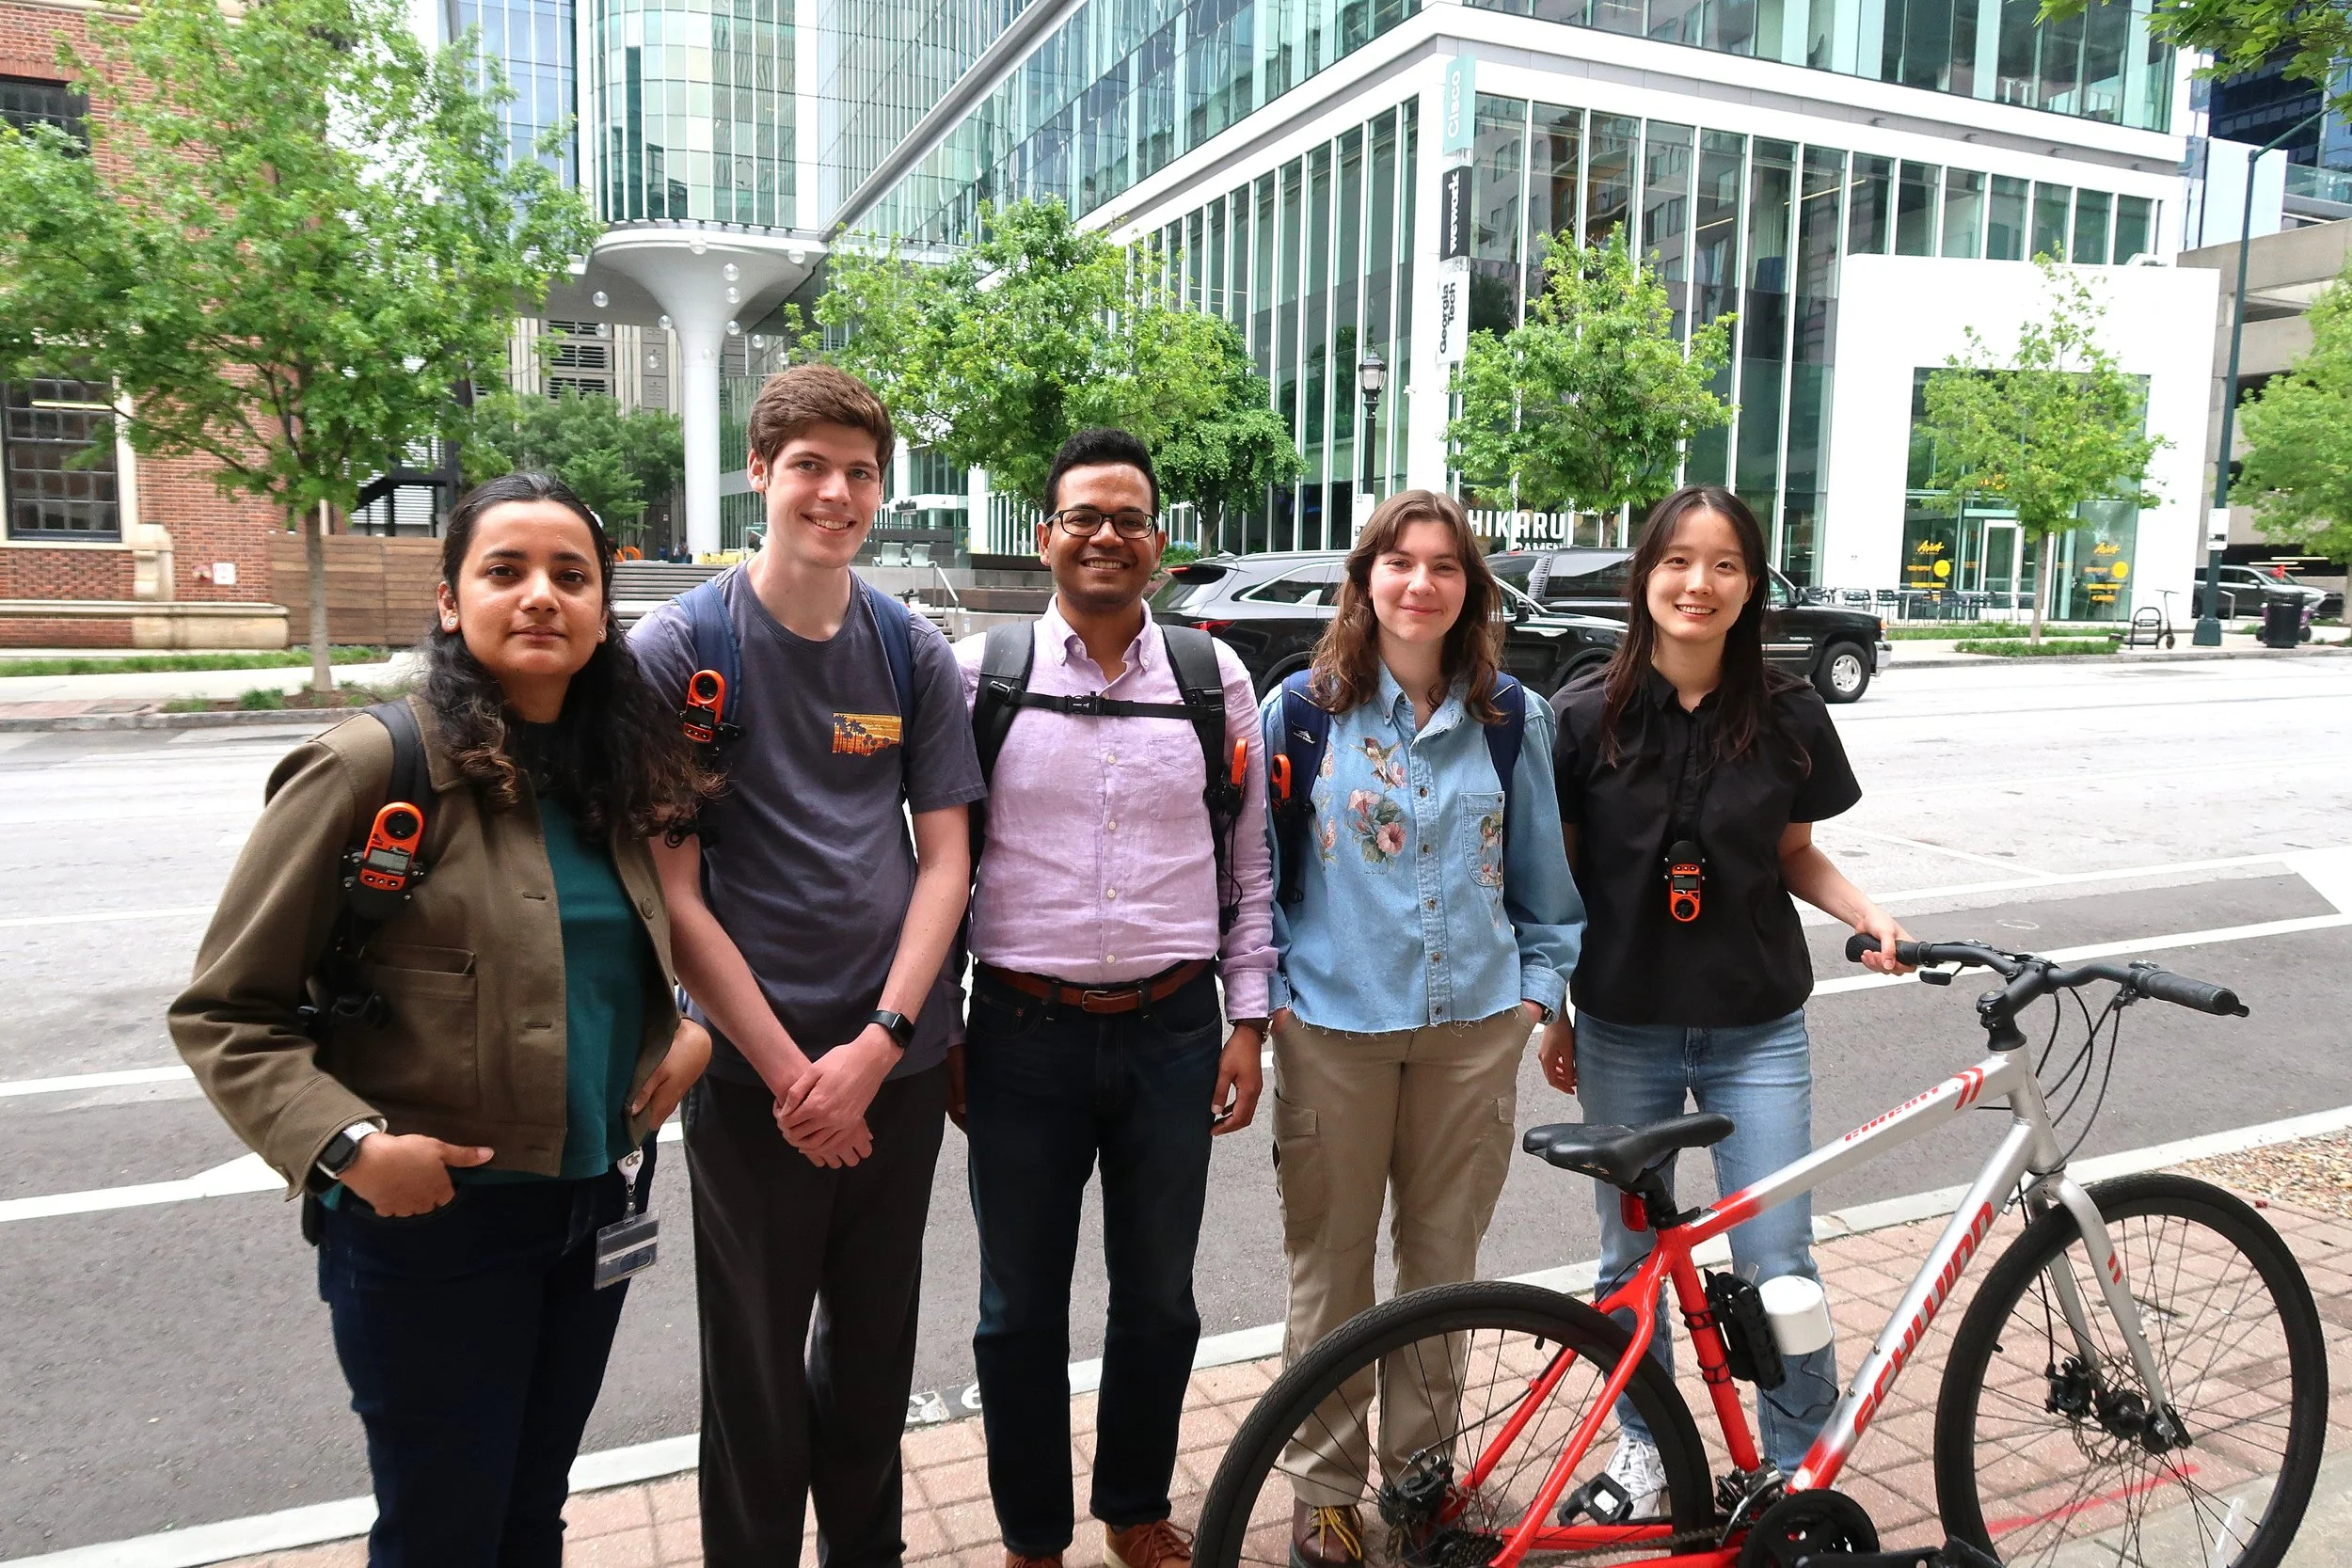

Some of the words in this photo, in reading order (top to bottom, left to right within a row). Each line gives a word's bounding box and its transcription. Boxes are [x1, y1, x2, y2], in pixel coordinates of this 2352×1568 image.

[1439, 284, 1450, 355] Georgia
[1448, 282, 1456, 325] Tech
[1468, 509, 1565, 539] HIKARU
